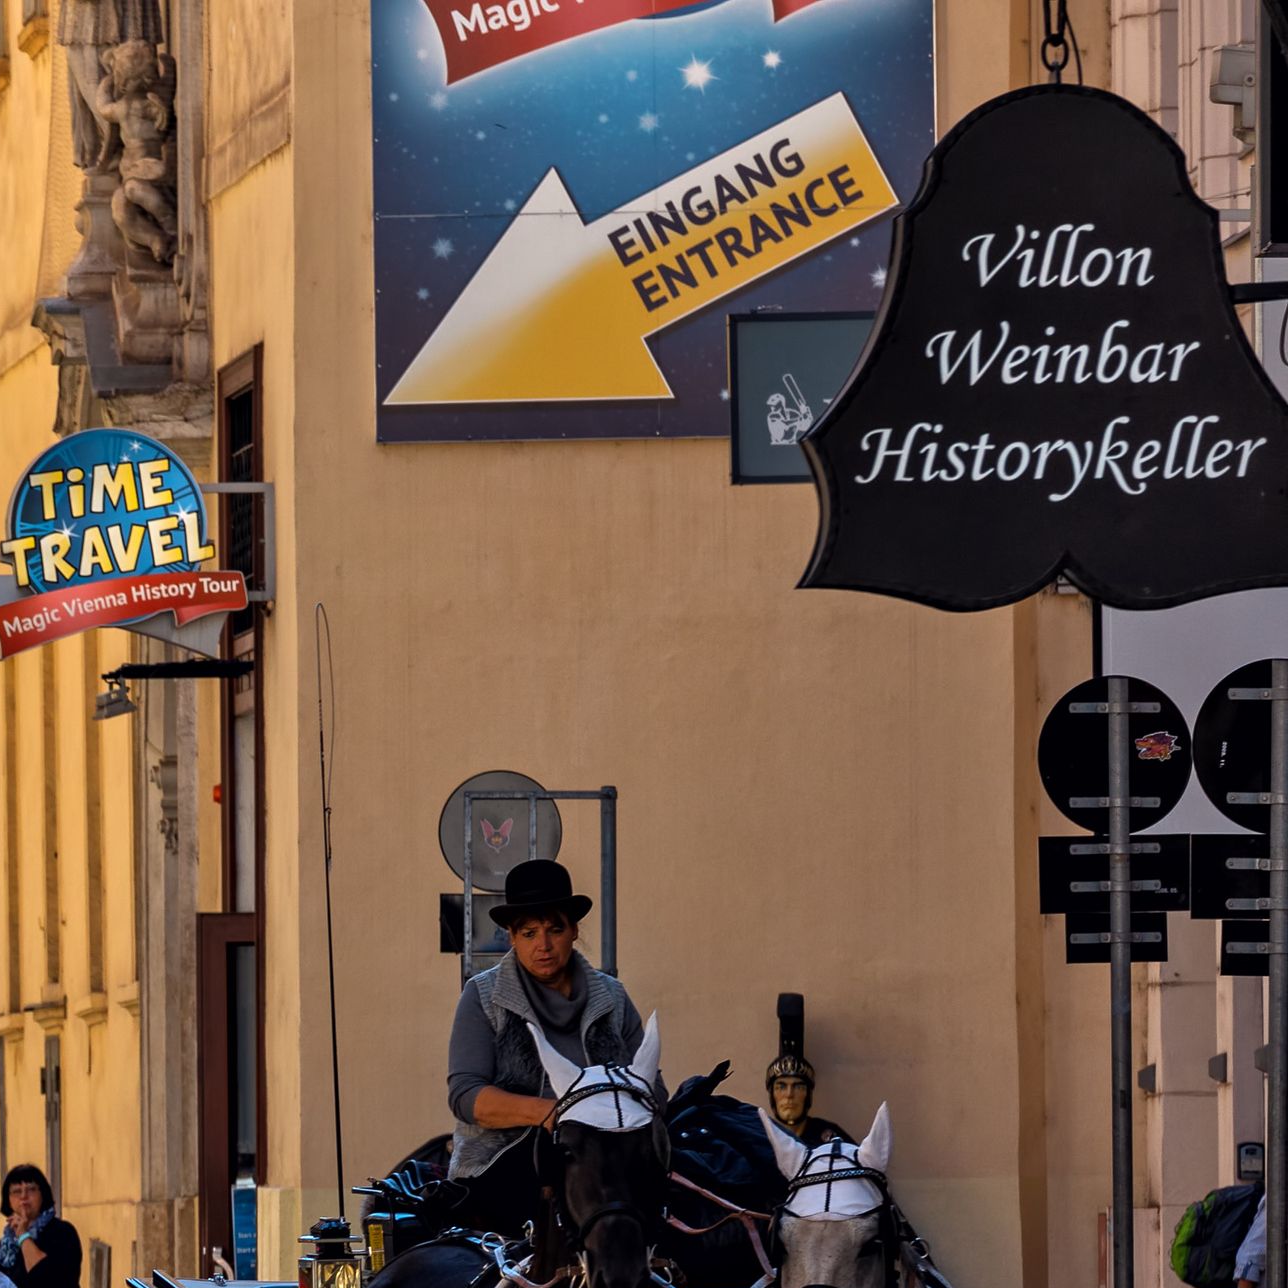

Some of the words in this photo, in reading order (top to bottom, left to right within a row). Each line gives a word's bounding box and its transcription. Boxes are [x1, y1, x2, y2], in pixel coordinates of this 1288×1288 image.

[607, 138, 806, 267] EINGANG
[632, 164, 864, 313] ENTRANCE
[962, 223, 1155, 289] Villon
[924, 320, 1200, 387] Weinbar
[854, 415, 1268, 502] Historykeller
[0, 511, 216, 588] TRAVEL
[2, 607, 61, 638] Magic
[62, 593, 128, 618] Vienna
[131, 580, 197, 603] History
[199, 577, 240, 594] Tour
